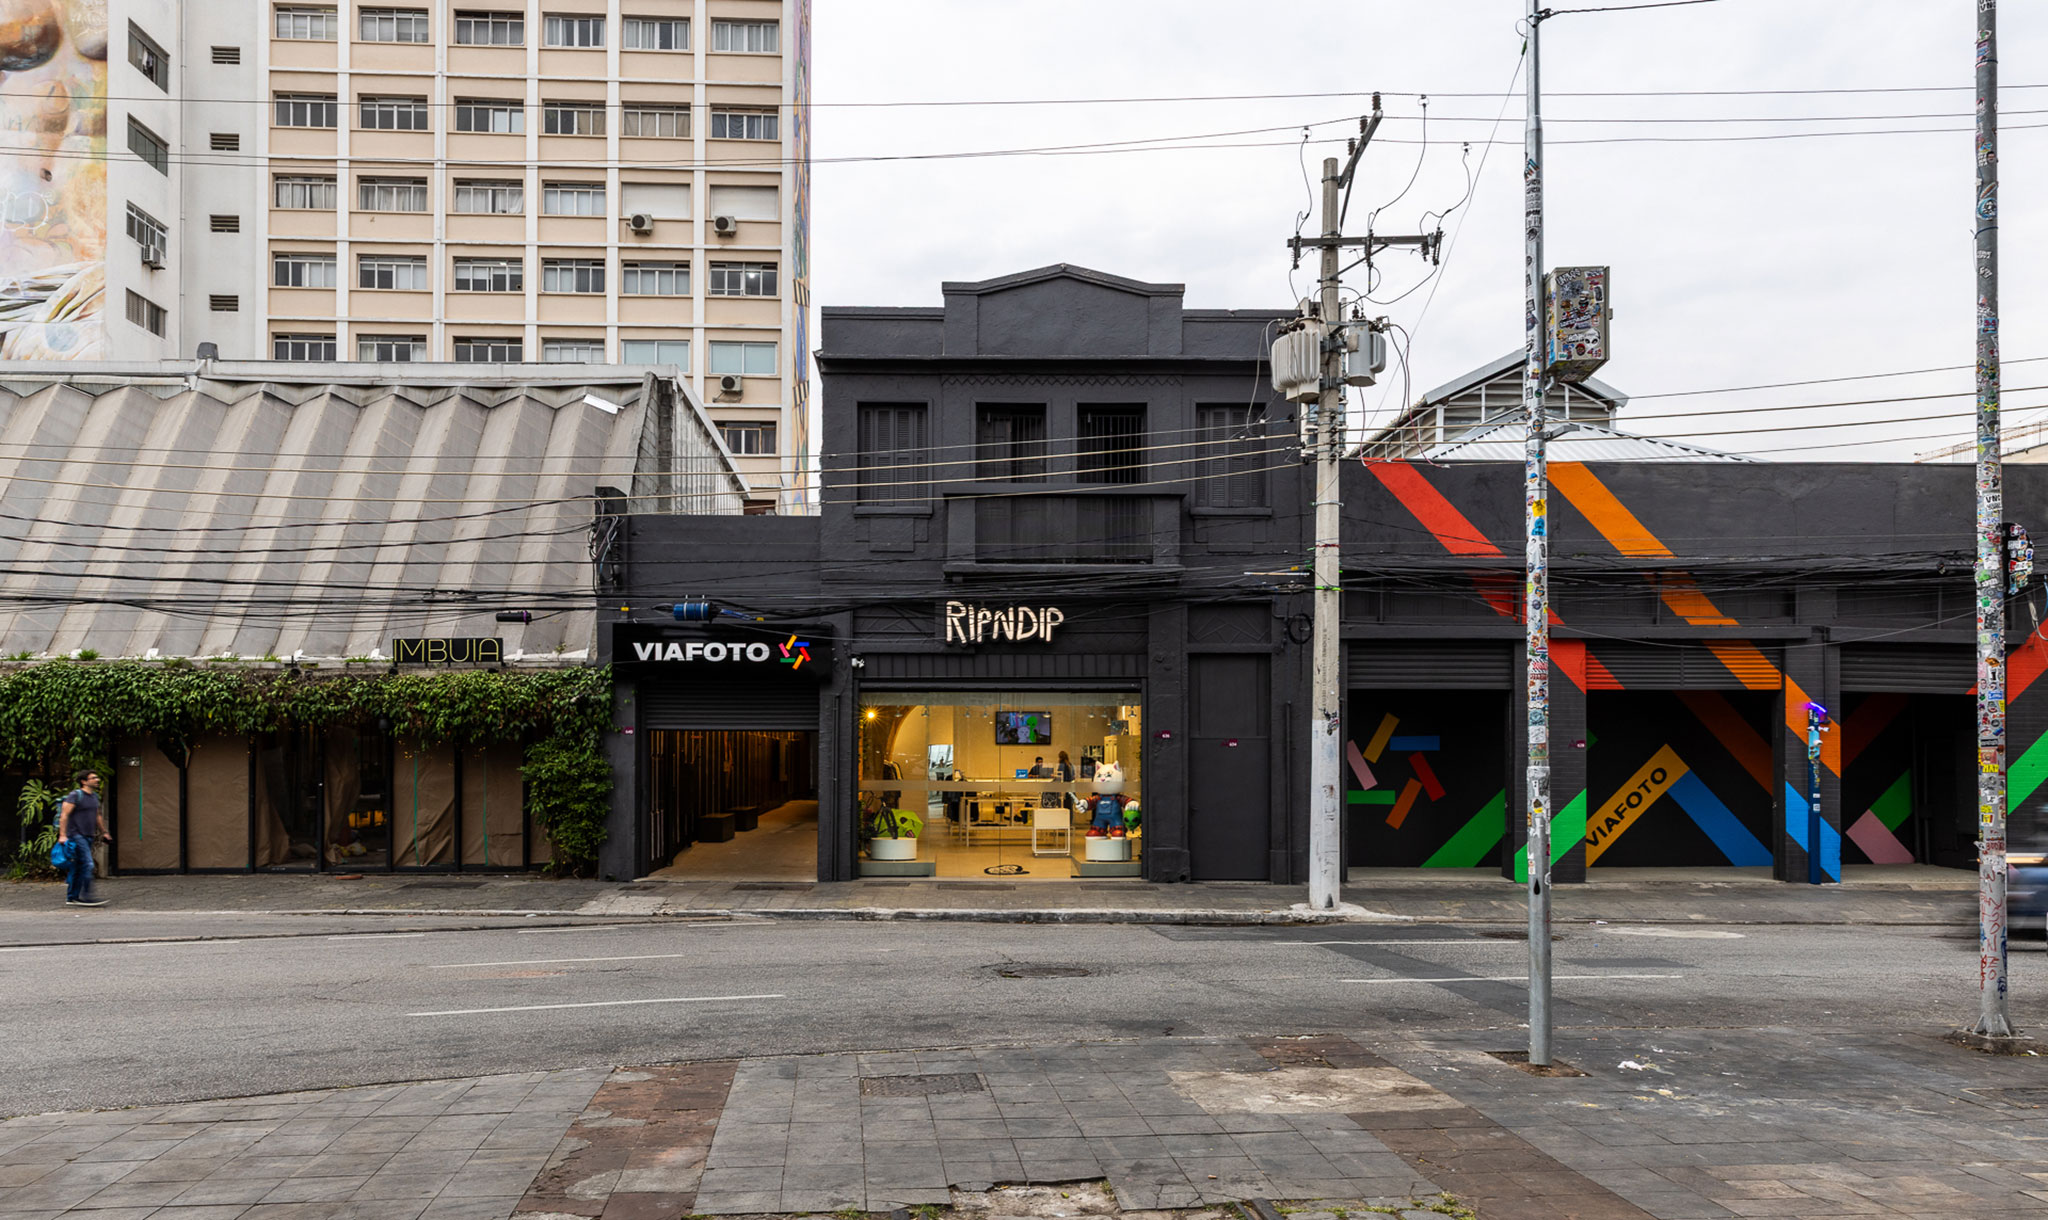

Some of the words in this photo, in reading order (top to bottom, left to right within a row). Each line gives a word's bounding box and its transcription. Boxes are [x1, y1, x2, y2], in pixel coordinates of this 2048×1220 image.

[946, 601, 1064, 643] RIPNDIP
[394, 638, 499, 662] IMBUIA
[633, 642, 770, 662] VIAFOTO
[1585, 767, 1667, 847] VIAFOTO
